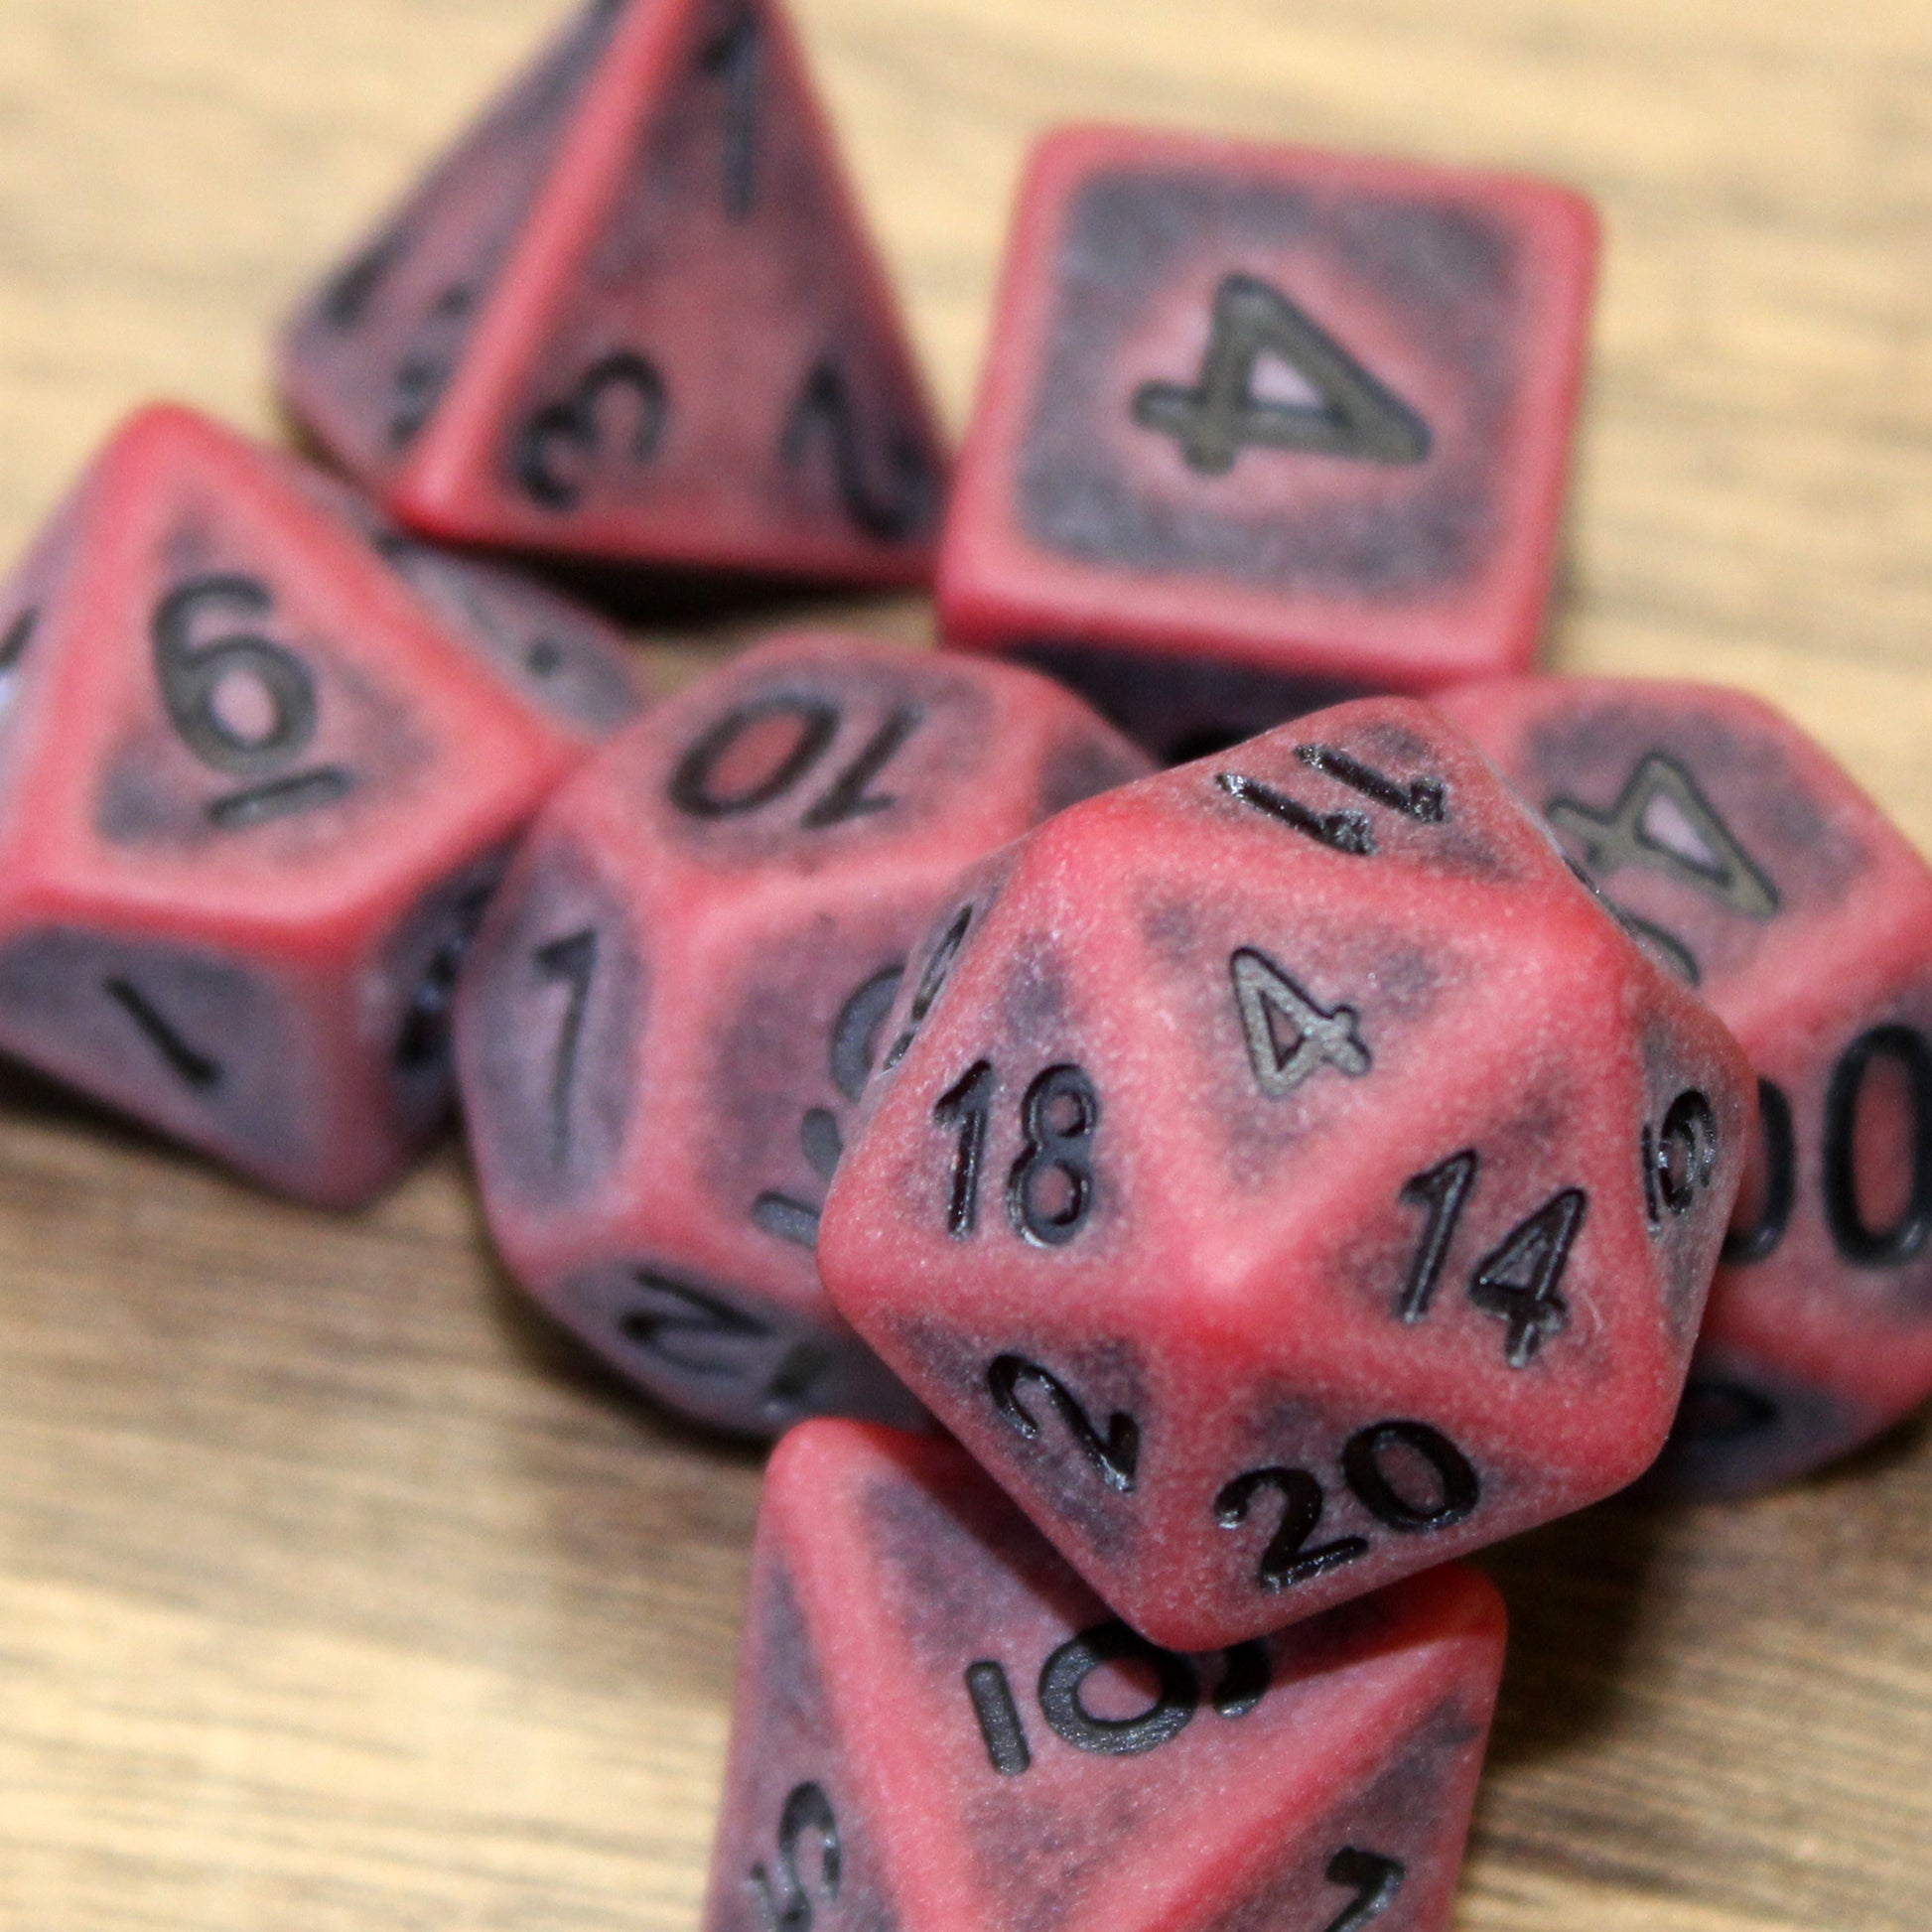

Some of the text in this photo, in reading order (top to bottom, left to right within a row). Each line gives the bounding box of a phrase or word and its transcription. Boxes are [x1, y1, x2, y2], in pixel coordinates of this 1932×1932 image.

[513, 347, 669, 512] 3
[1131, 271, 1433, 476] 4
[669, 693, 919, 830] 10
[1215, 743, 1447, 856] 11
[1545, 751, 1780, 987] 4
[1230, 946, 1372, 1100] 4
[933, 1059, 1098, 1248] 18
[1401, 1149, 1587, 1369] 14
[987, 1353, 1142, 1493] 2
[1214, 1419, 1480, 1589] 20
